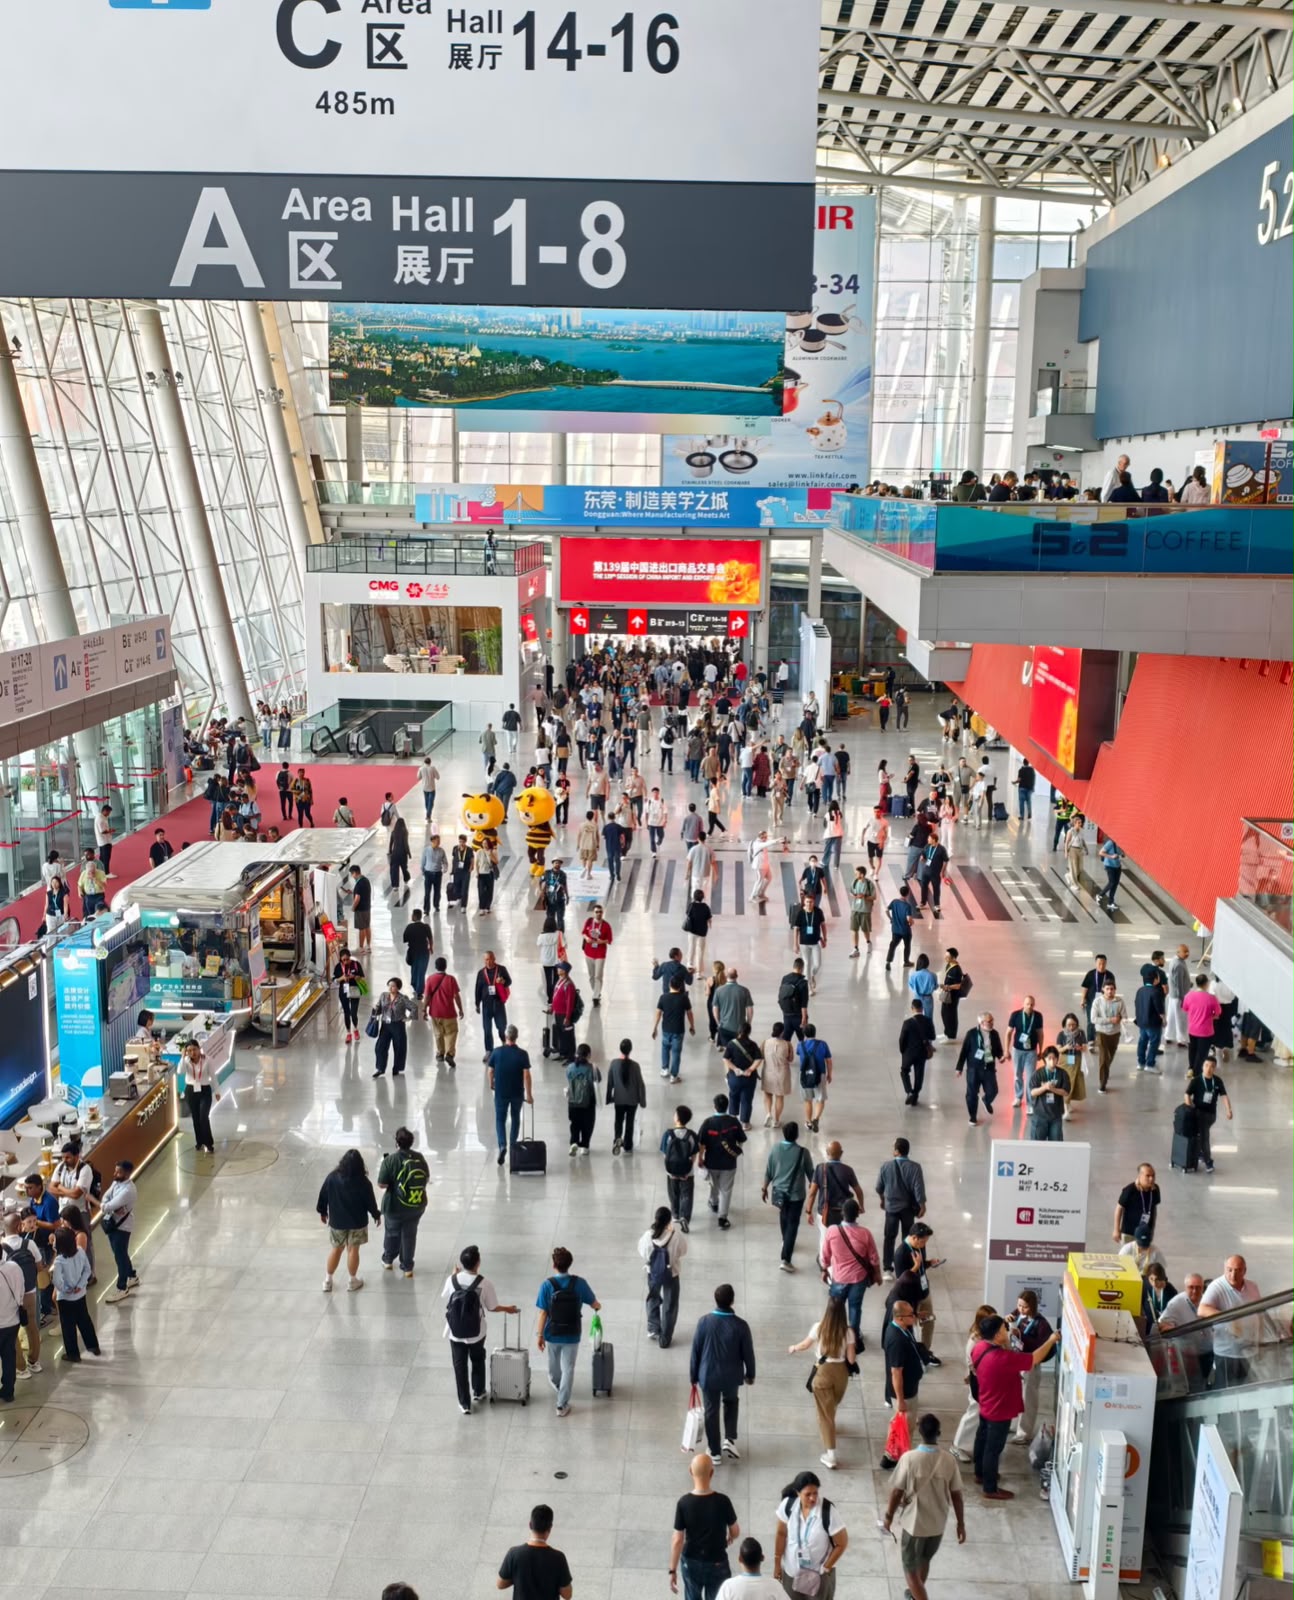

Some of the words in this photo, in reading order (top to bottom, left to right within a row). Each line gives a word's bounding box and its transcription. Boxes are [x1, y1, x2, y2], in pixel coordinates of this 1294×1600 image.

[276, 0, 342, 69] C
[447, 10, 504, 34] Hall
[512, 11, 681, 74] 14-16
[366, 23, 408, 69] 区
[448, 43, 504, 71] 展厅
[315, 90, 395, 116] 485m
[169, 187, 266, 288] A
[281, 188, 373, 223] Area
[391, 198, 475, 233] Hall
[493, 198, 628, 290] 1-8
[288, 231, 343, 290] 区
[394, 246, 475, 287] 展厅
[788, 472, 857, 480] www.linkfair.com
[584, 490, 728, 511] 东莞·制造美学之城
[1145, 529, 1243, 552] COFFEE
[368, 580, 399, 591] CMG
[650, 617, 656, 626] B
[122, 634, 127, 648] B
[1018, 1163, 1034, 1176] 2F
[1034, 1181, 1068, 1192] 1.2-5.2
[1005, 1244, 1022, 1257] LF
